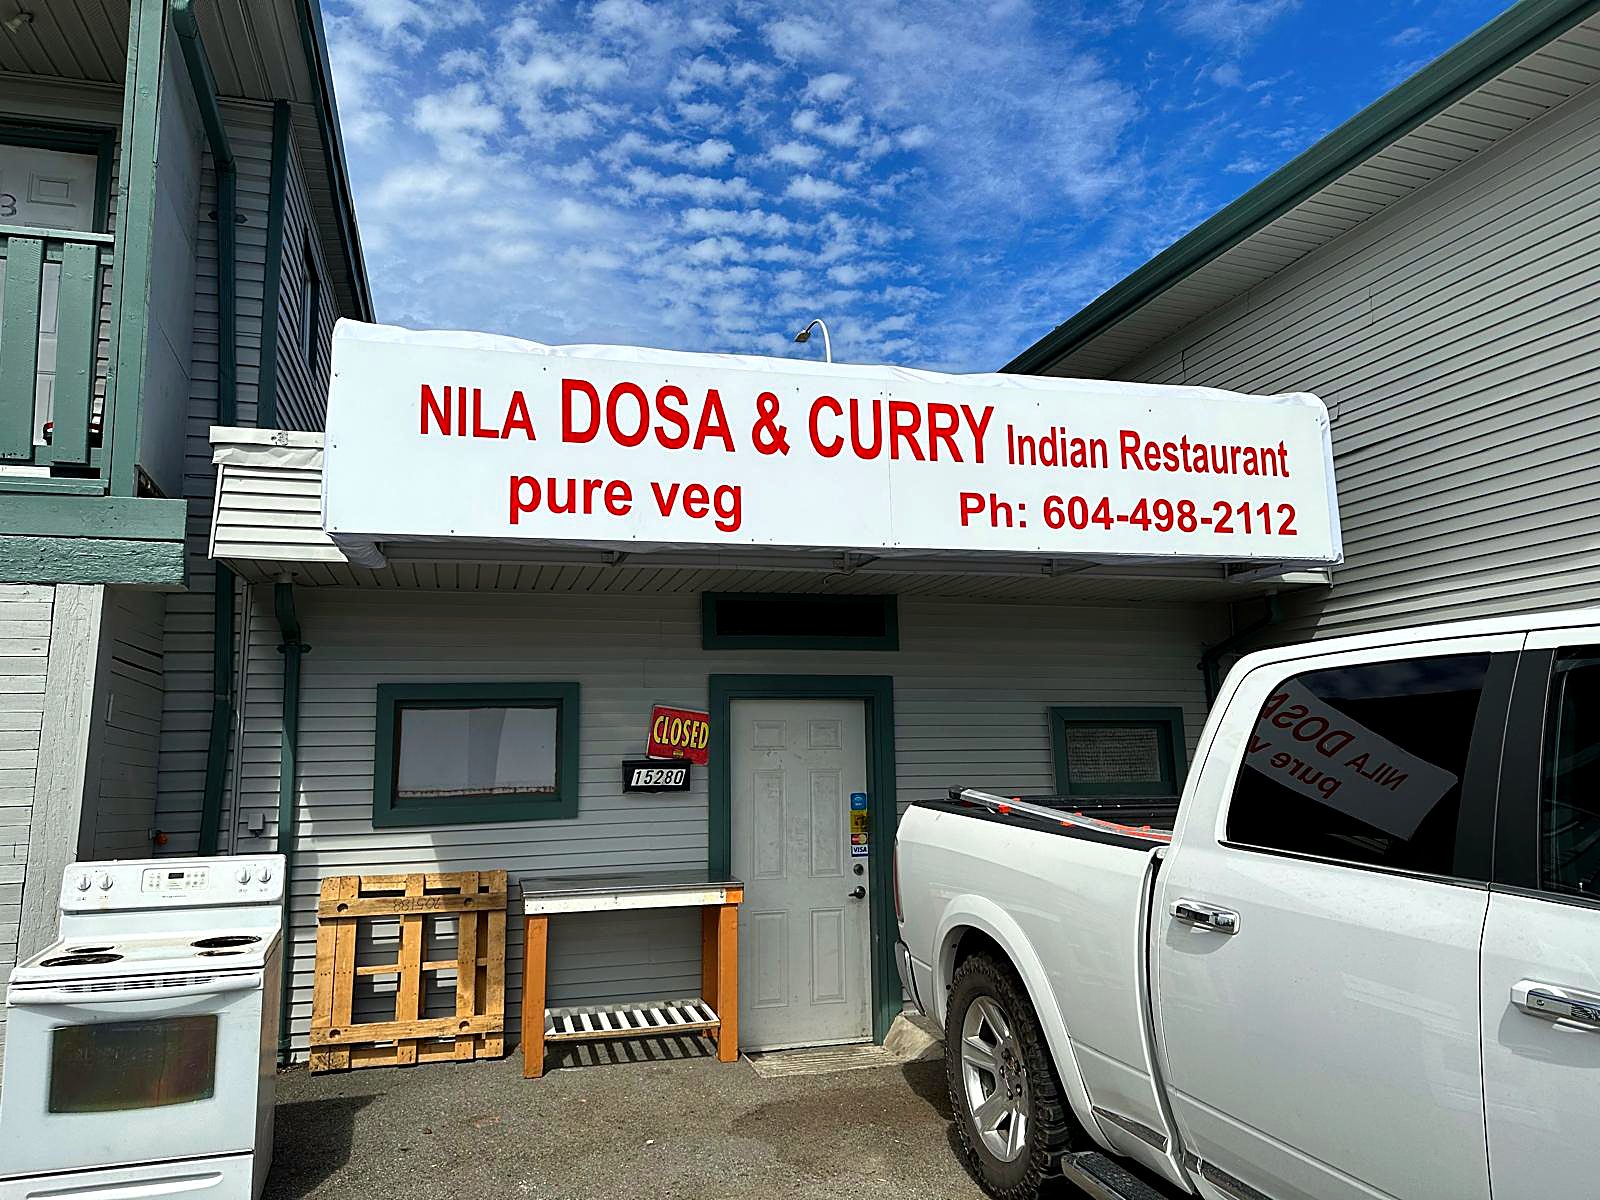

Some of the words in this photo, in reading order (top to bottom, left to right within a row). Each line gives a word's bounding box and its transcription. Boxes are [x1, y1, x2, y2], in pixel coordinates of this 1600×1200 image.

[421, 384, 535, 440] NILA
[562, 379, 734, 452] DOSA
[752, 392, 790, 455] &
[809, 396, 993, 463] CURRY
[1008, 424, 1107, 468] Indian
[1120, 430, 1289, 477] Restaurant
[510, 475, 632, 526] pure
[651, 482, 742, 532] veg
[960, 492, 1027, 528] Ph:
[1043, 496, 1297, 535] 604-498-2112
[653, 715, 709, 750] CLOSED
[635, 770, 684, 785] 15280
